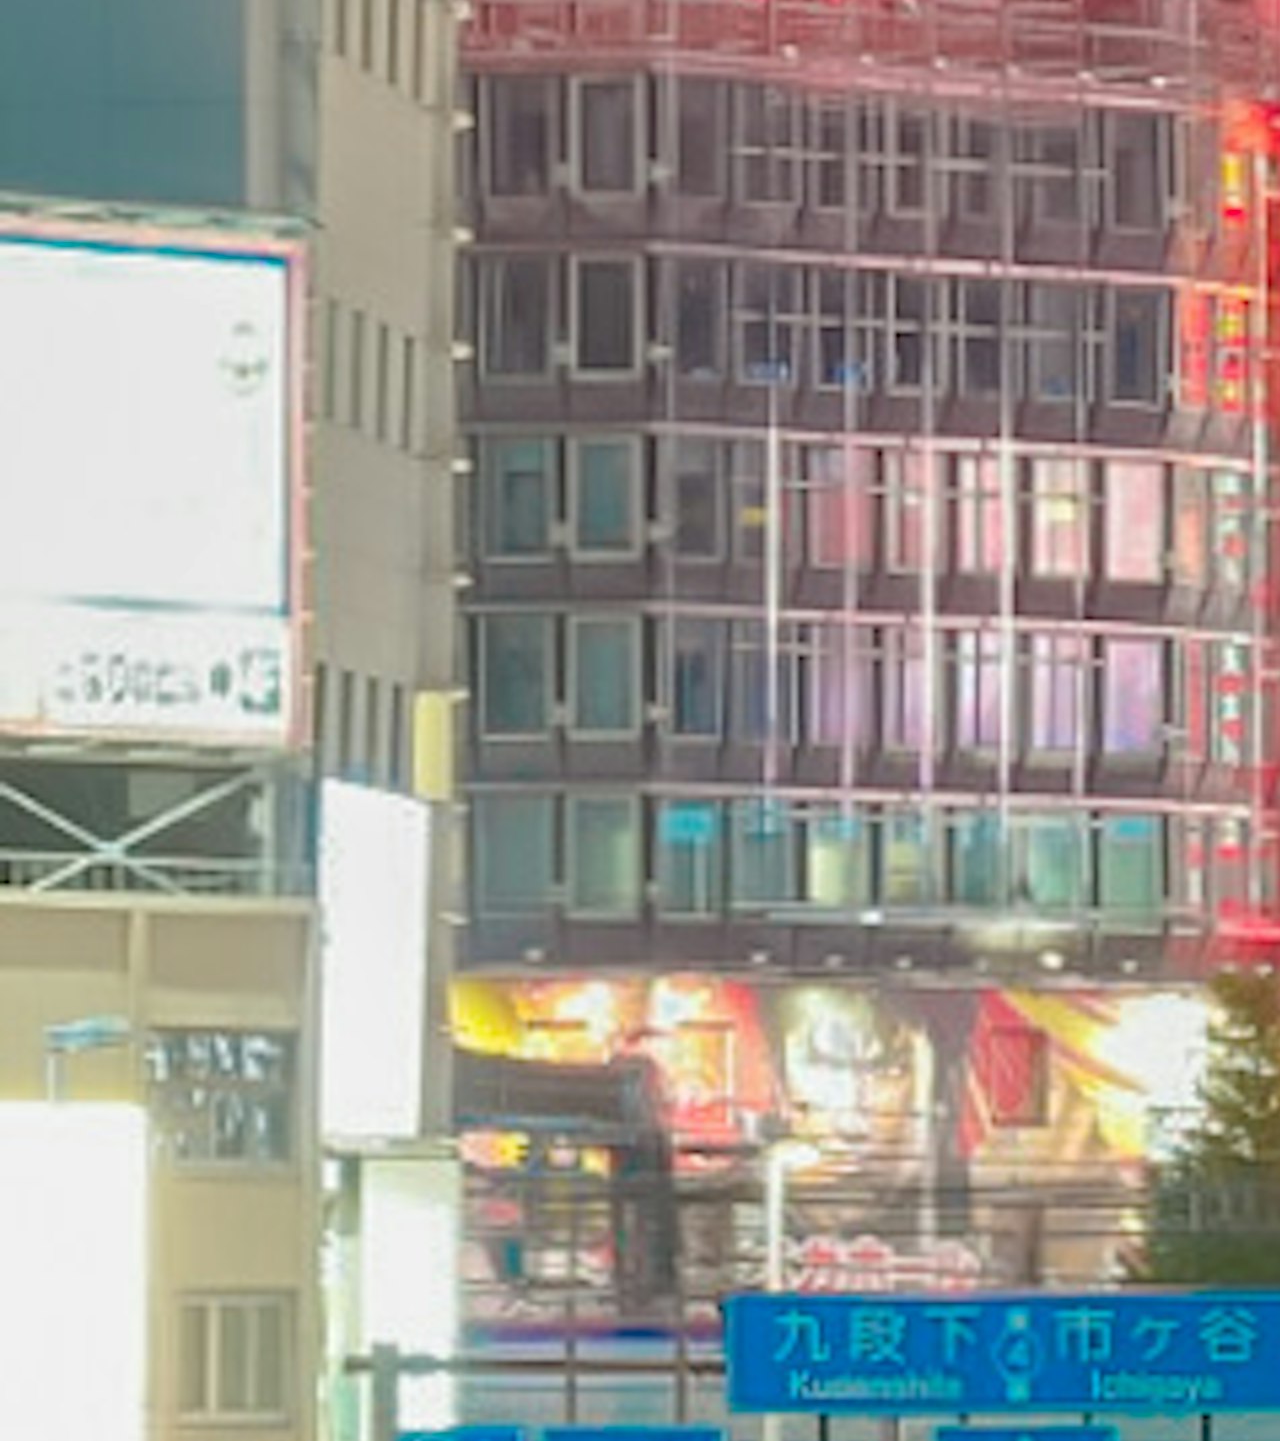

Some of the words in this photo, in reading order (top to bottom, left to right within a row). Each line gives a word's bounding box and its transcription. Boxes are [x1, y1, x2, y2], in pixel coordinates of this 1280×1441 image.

[773, 1306, 980, 1363] 九段下
[789, 1370, 963, 1400] Kudanshita
[1091, 1370, 1222, 1407] Ichigaya
